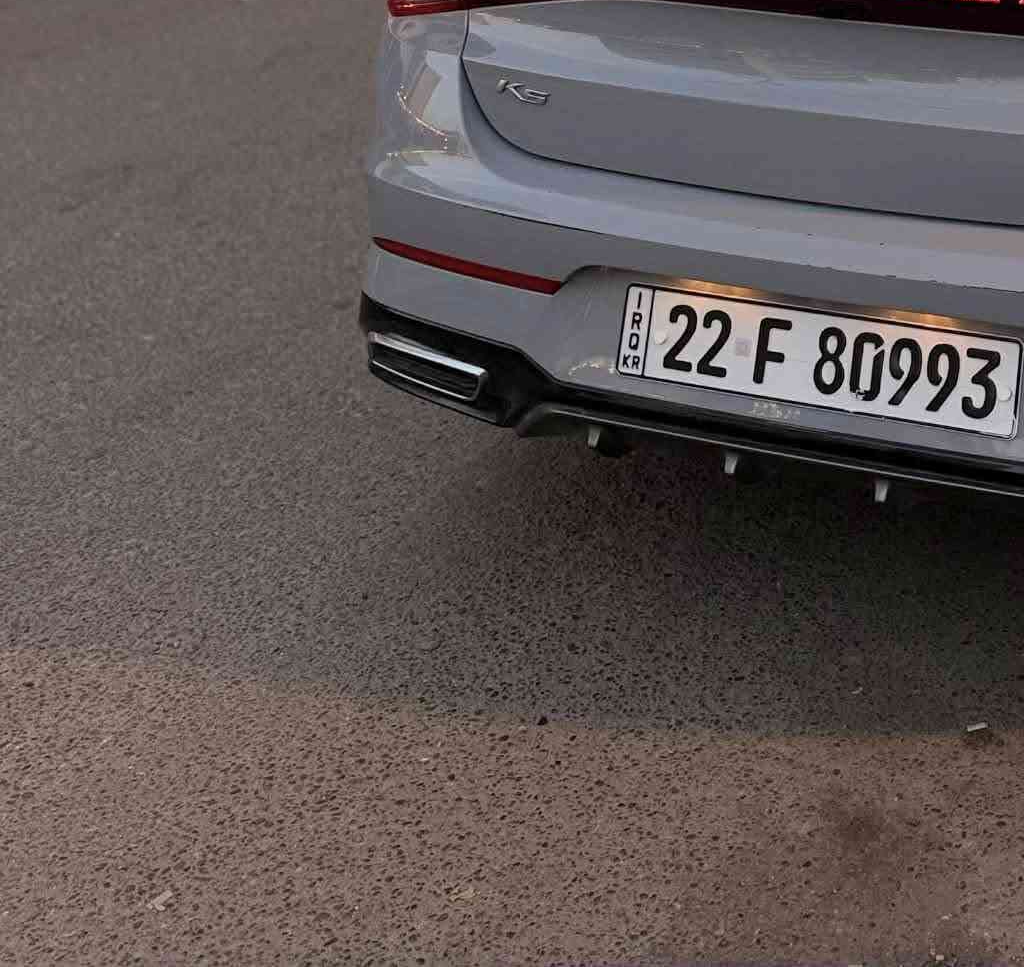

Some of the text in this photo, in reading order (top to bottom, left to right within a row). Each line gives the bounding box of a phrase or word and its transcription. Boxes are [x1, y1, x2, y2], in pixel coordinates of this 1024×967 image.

[497, 79, 551, 105] K5
[622, 354, 641, 370] KR
[663, 304, 1001, 419] 22 F 80993
